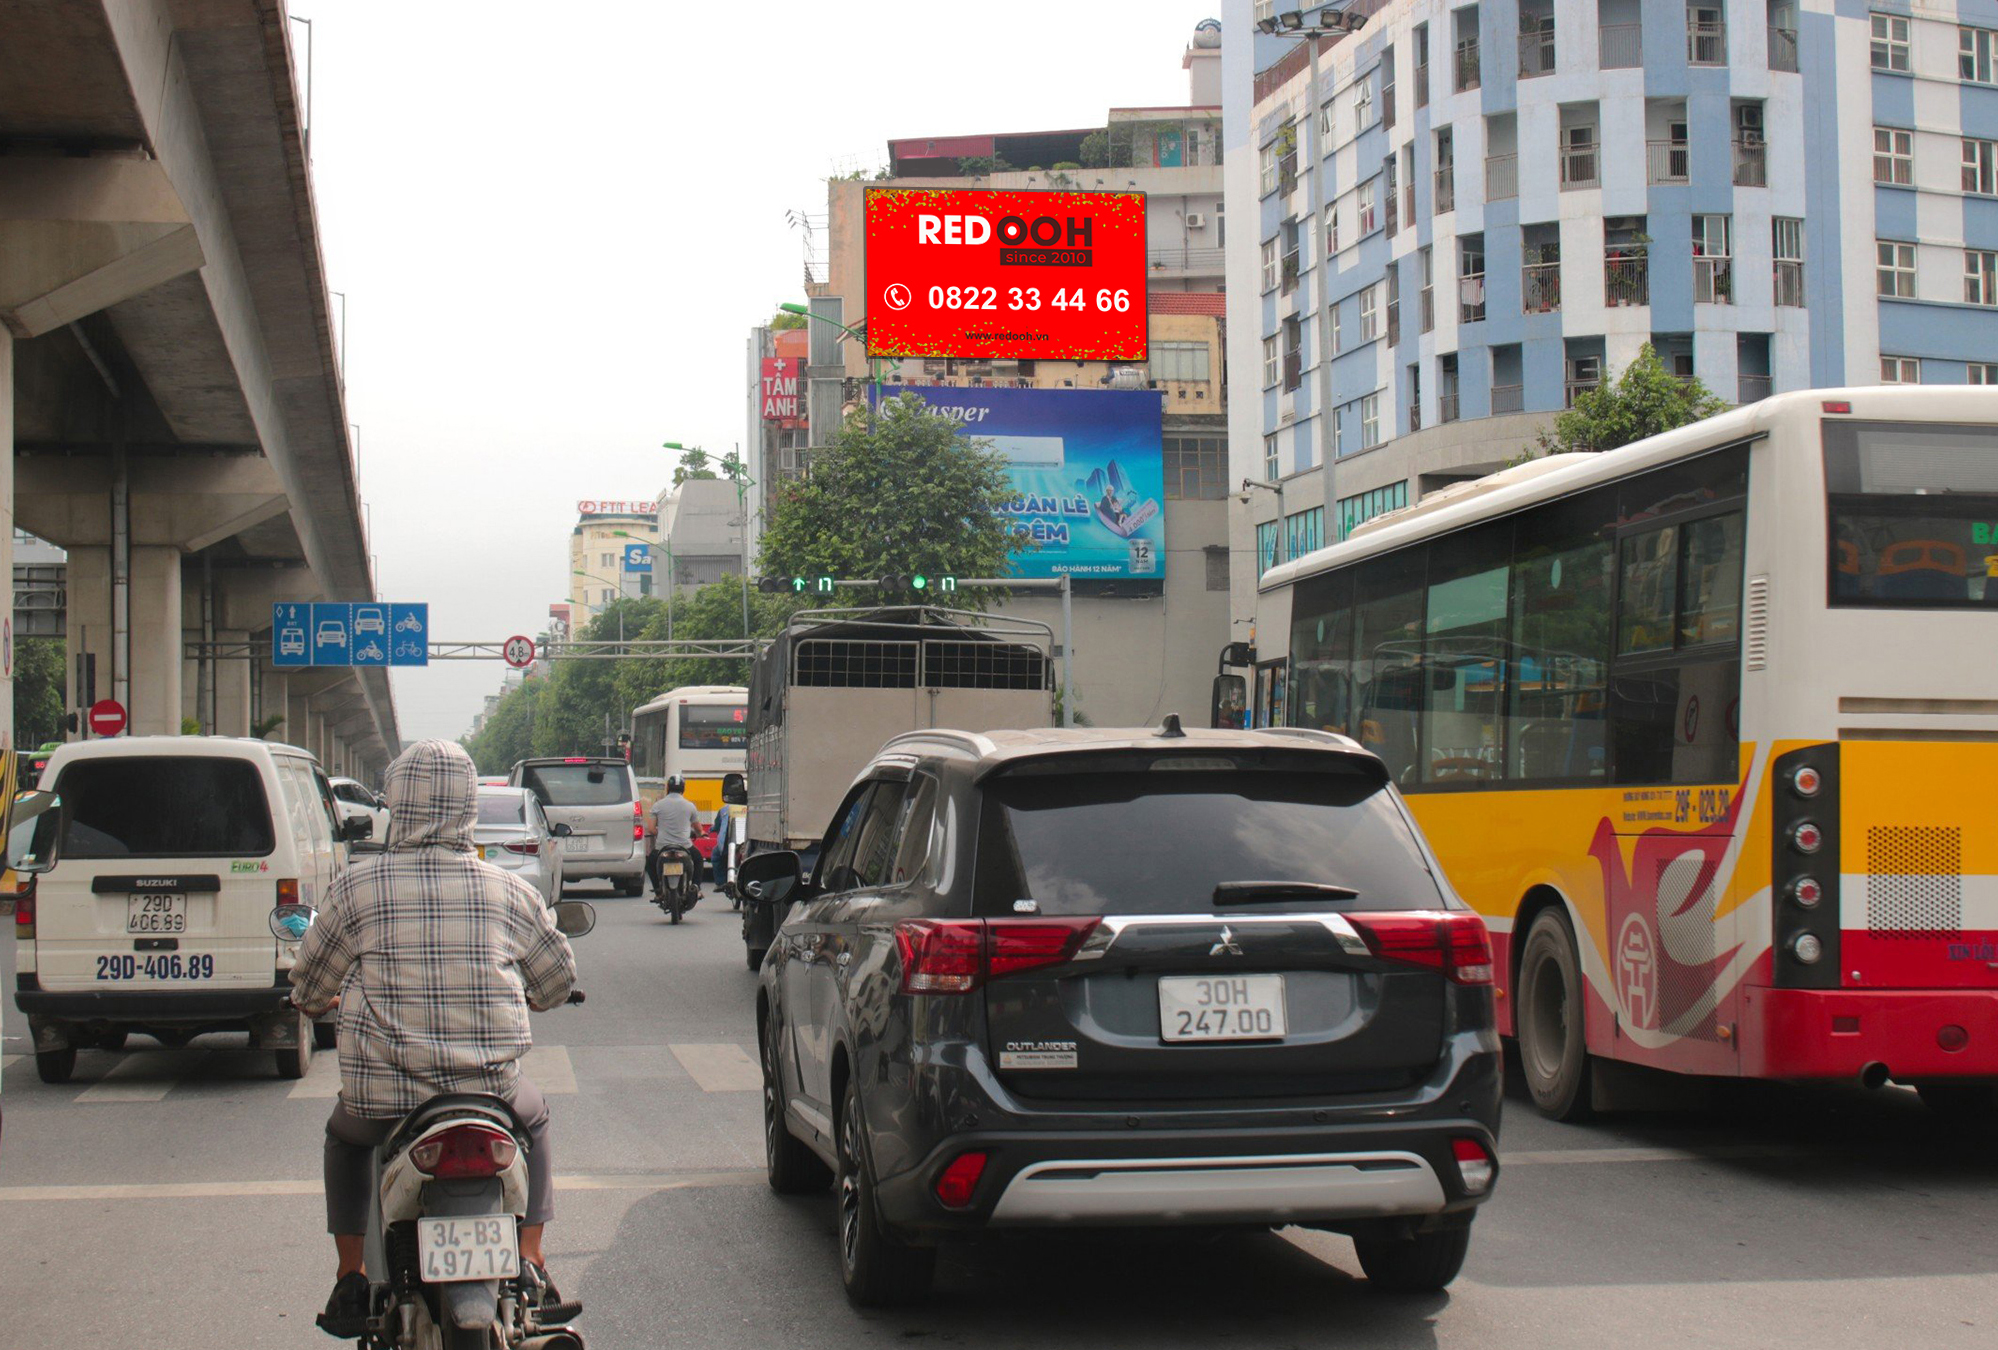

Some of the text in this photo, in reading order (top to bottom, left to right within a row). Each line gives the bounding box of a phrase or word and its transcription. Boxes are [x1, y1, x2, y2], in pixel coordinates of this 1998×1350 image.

[918, 214, 1092, 247] RED OOH
[1005, 251, 1086, 264] since 2010
[928, 286, 1130, 312] 0822 33 44 66
[965, 331, 1049, 342] www.redooh.vn
[763, 372, 797, 395] TÂM
[763, 398, 797, 416] ANH
[914, 397, 990, 425] asper
[1135, 547, 1148, 558] 12
[819, 577, 832, 591] 17
[942, 577, 955, 591] 17
[136, 879, 177, 887] SUZUKI
[143, 895, 172, 912] 29D
[130, 914, 184, 931] 406.89
[97, 954, 214, 980] 29D-406.89
[1196, 980, 1248, 1005] 30H
[1177, 1008, 1272, 1035] 247.00
[1006, 1041, 1077, 1051] OUTLANDER
[433, 1220, 502, 1248] 34-B3
[427, 1248, 513, 1277] 497.12
